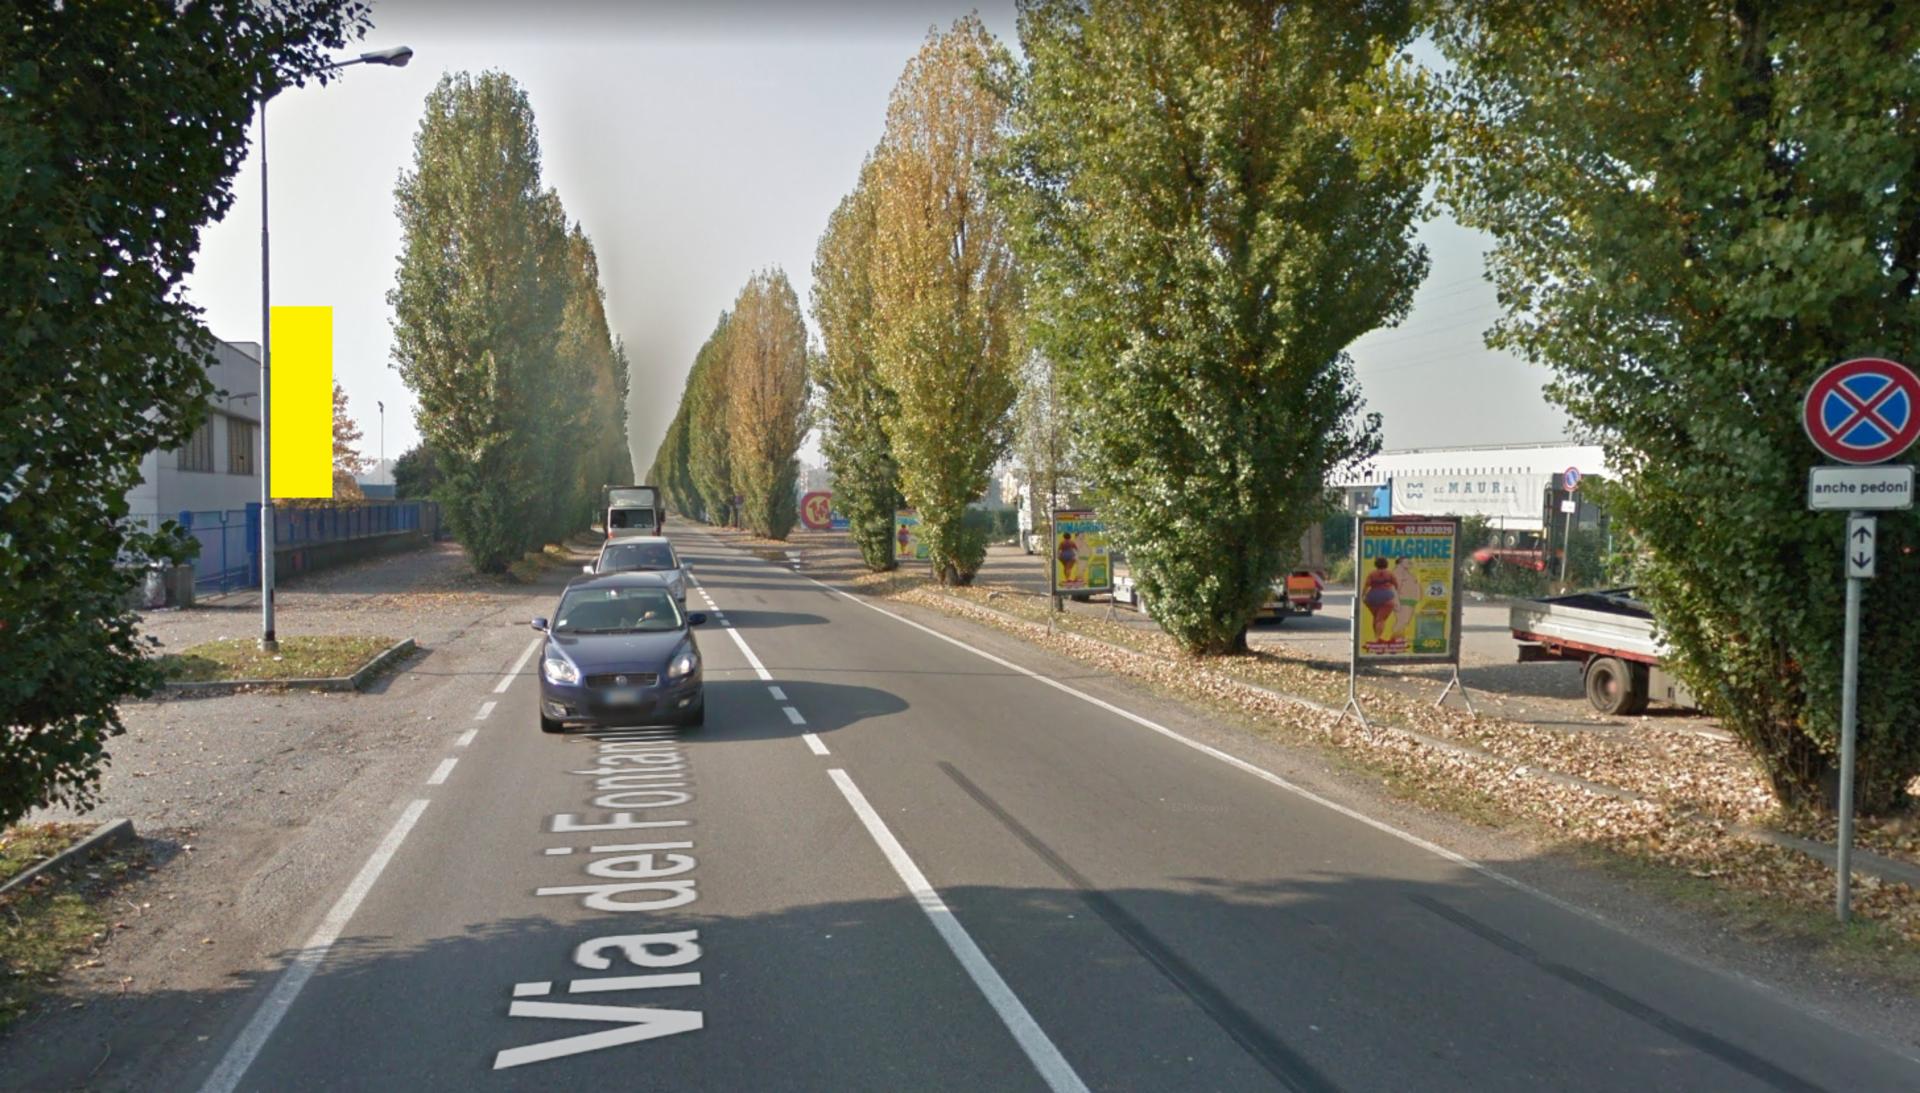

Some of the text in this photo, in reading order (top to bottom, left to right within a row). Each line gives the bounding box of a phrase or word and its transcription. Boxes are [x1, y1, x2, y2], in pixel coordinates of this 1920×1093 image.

[1815, 481, 1908, 495] anche pedoni
[1364, 537, 1454, 559] DIMAGRIRE
